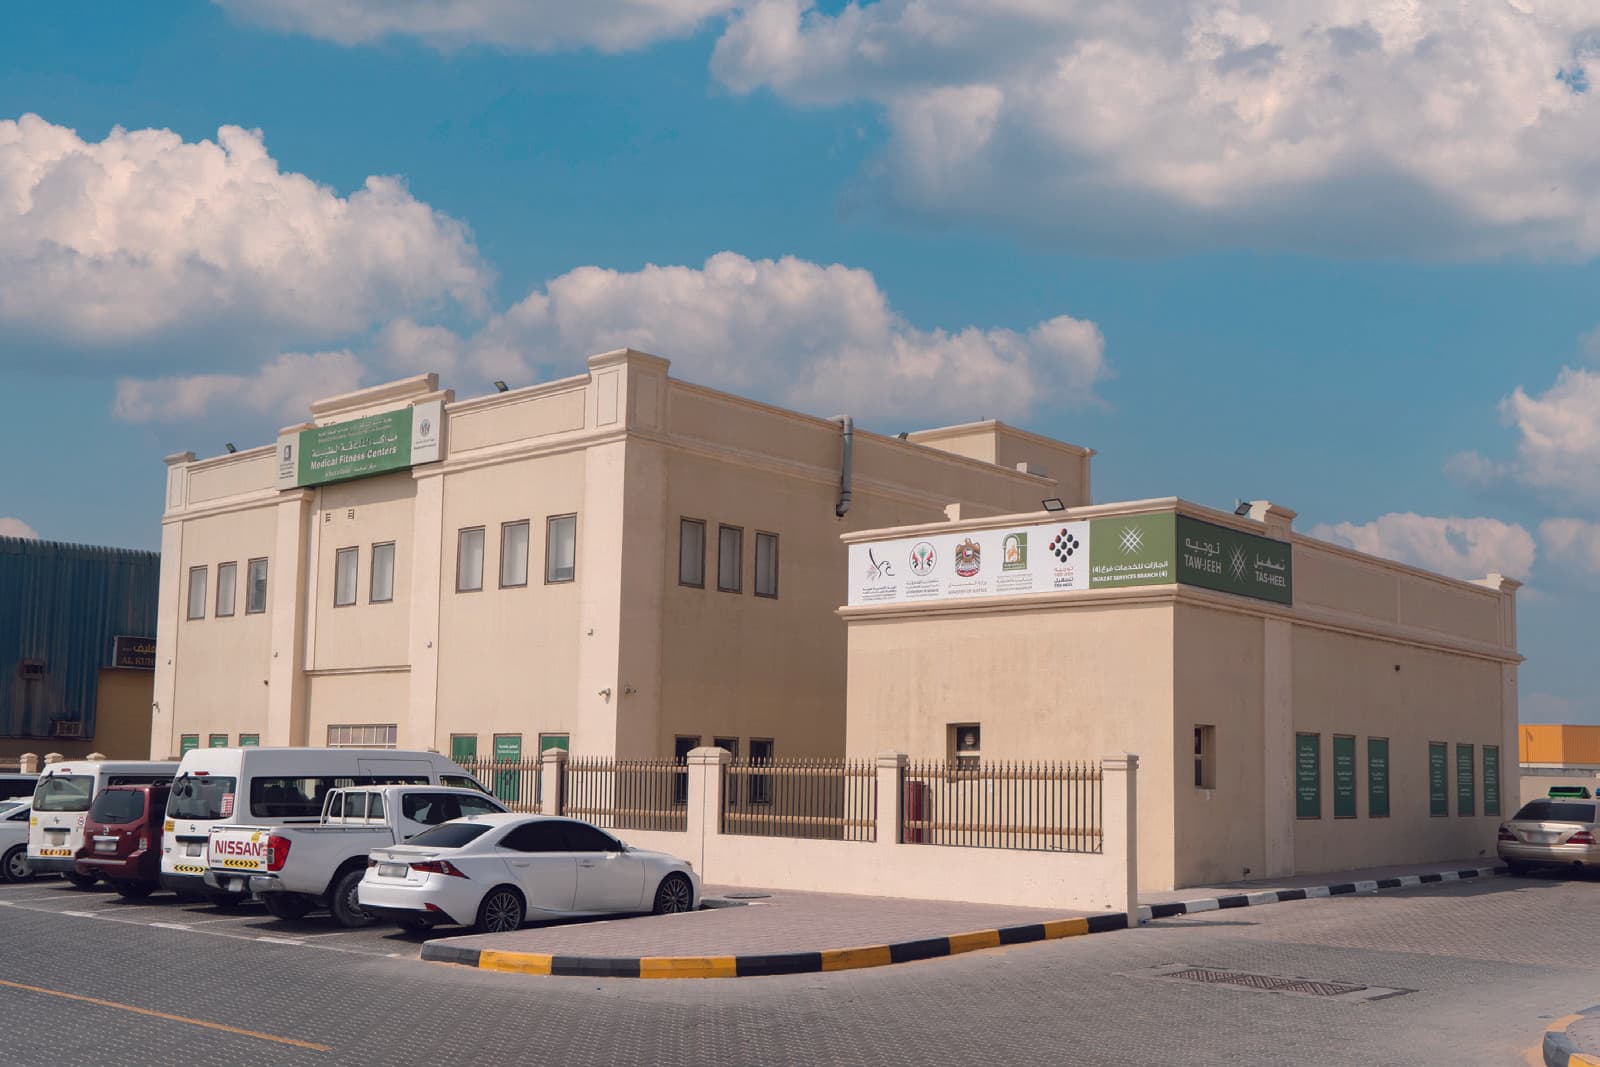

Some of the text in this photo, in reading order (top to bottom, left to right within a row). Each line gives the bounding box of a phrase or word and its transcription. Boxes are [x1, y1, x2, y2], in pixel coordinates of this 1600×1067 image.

[311, 446, 397, 470] Medical Fitness Centers
[1185, 538, 1220, 557] توجيه
[1184, 554, 1222, 574] TAW-JEEH
[1254, 553, 1285, 570] تسهيل
[1256, 571, 1287, 587] TAS-HEEL
[215, 840, 260, 856] NISSAN
